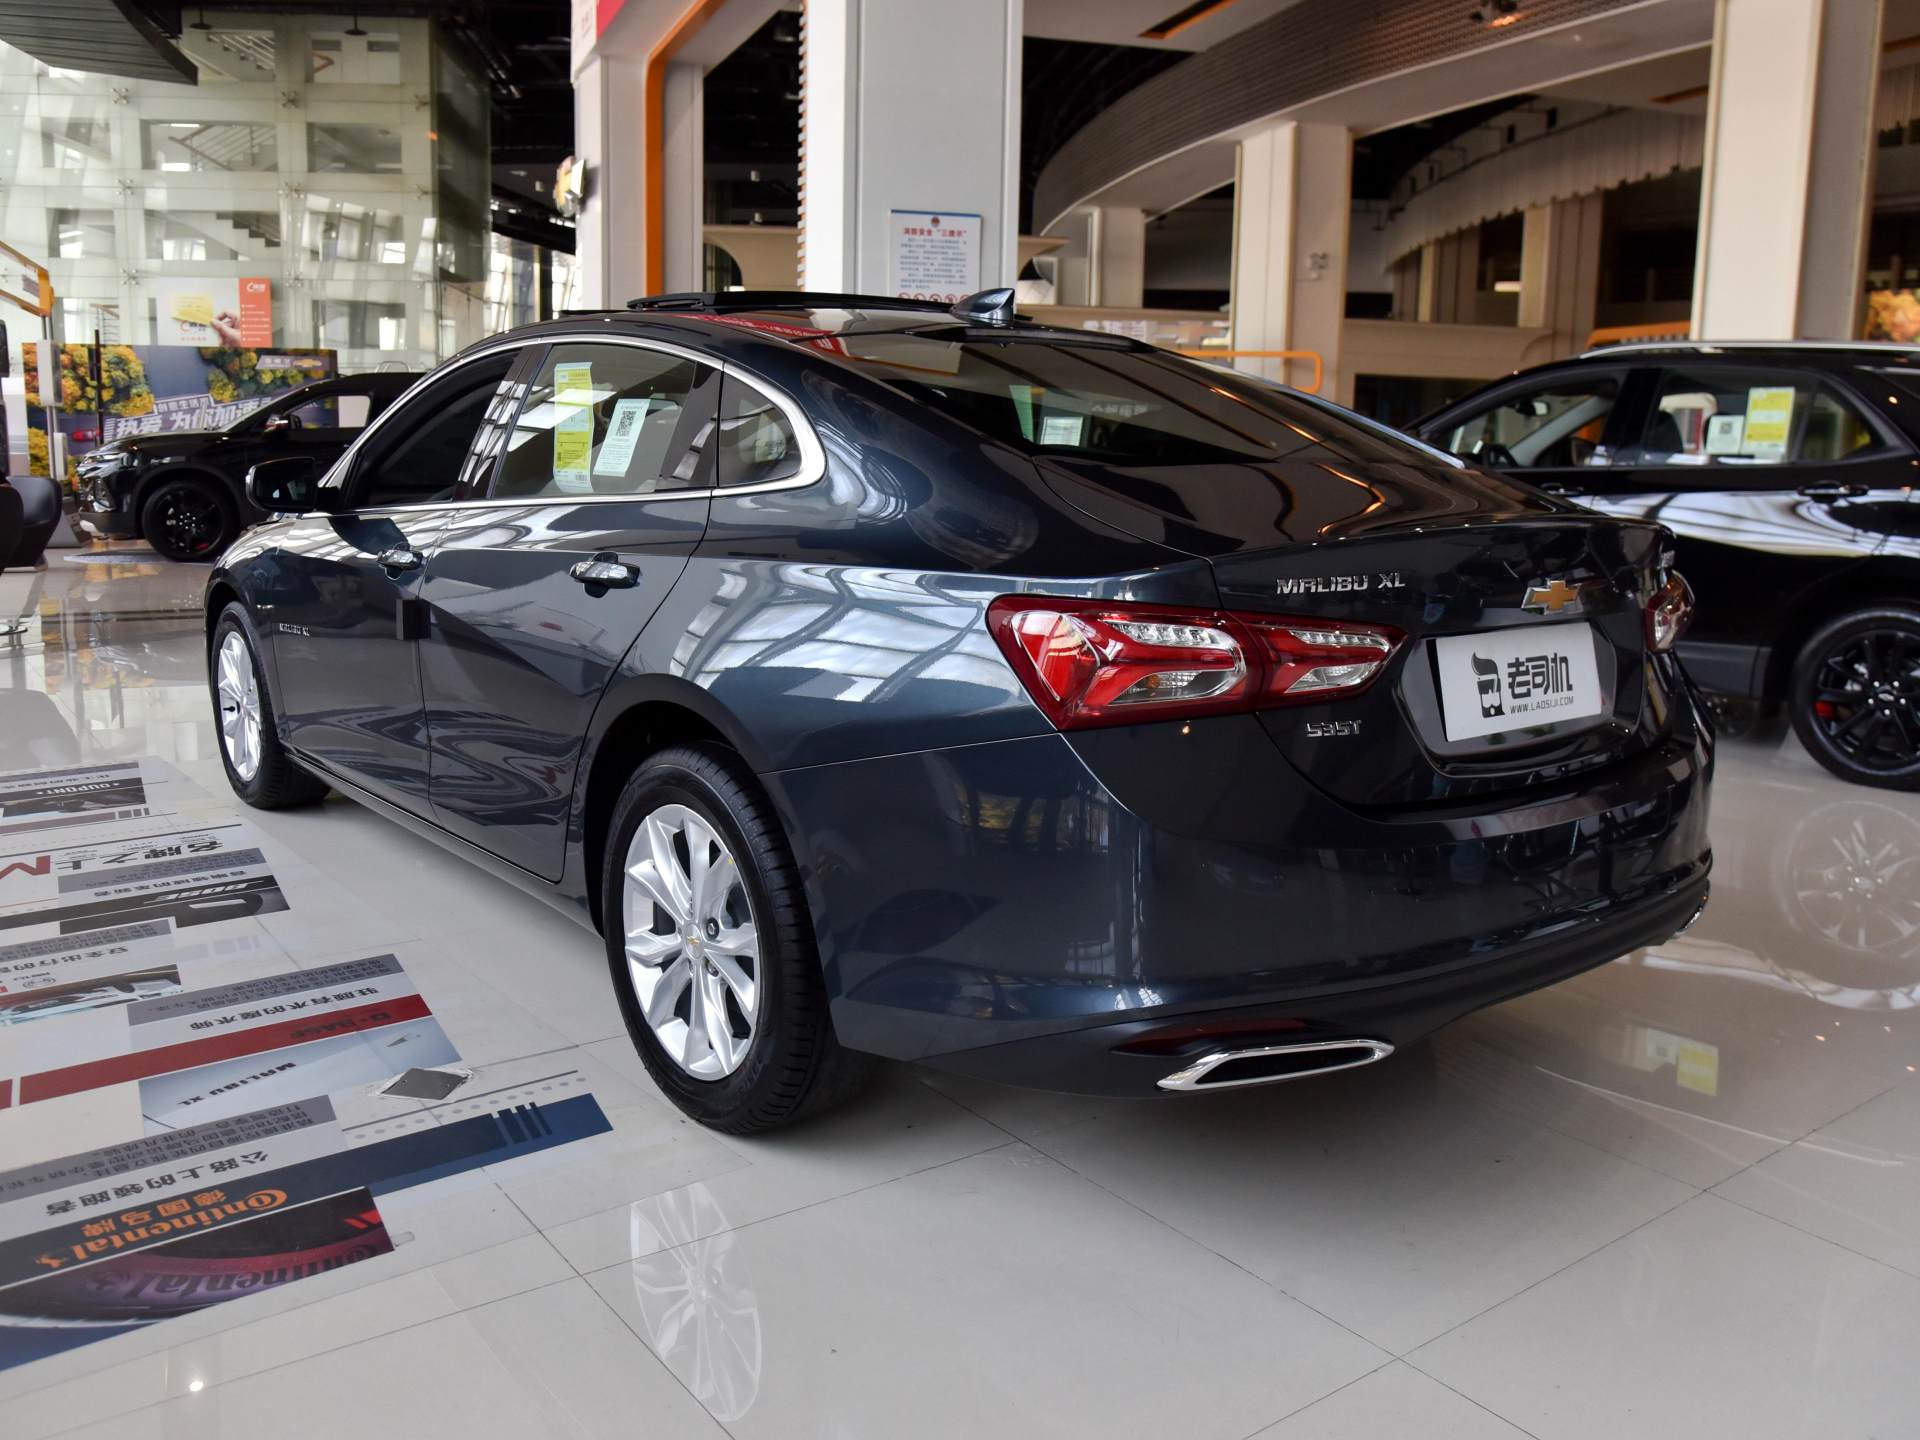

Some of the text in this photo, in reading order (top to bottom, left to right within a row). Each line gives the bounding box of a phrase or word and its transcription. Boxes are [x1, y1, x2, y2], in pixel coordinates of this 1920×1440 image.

[1277, 572, 1406, 594] MALIBU XL
[1507, 652, 1573, 700] 老司机
[1509, 696, 1574, 715] WWW.LAOSIJI.COM
[154, 882, 251, 901] BOSE
[210, 1062, 297, 1096] MALIBU
[46, 1150, 269, 1216] 公路上的领跑者
[73, 1188, 288, 1261] Continental
[80, 1189, 227, 1238] 德国马牌
